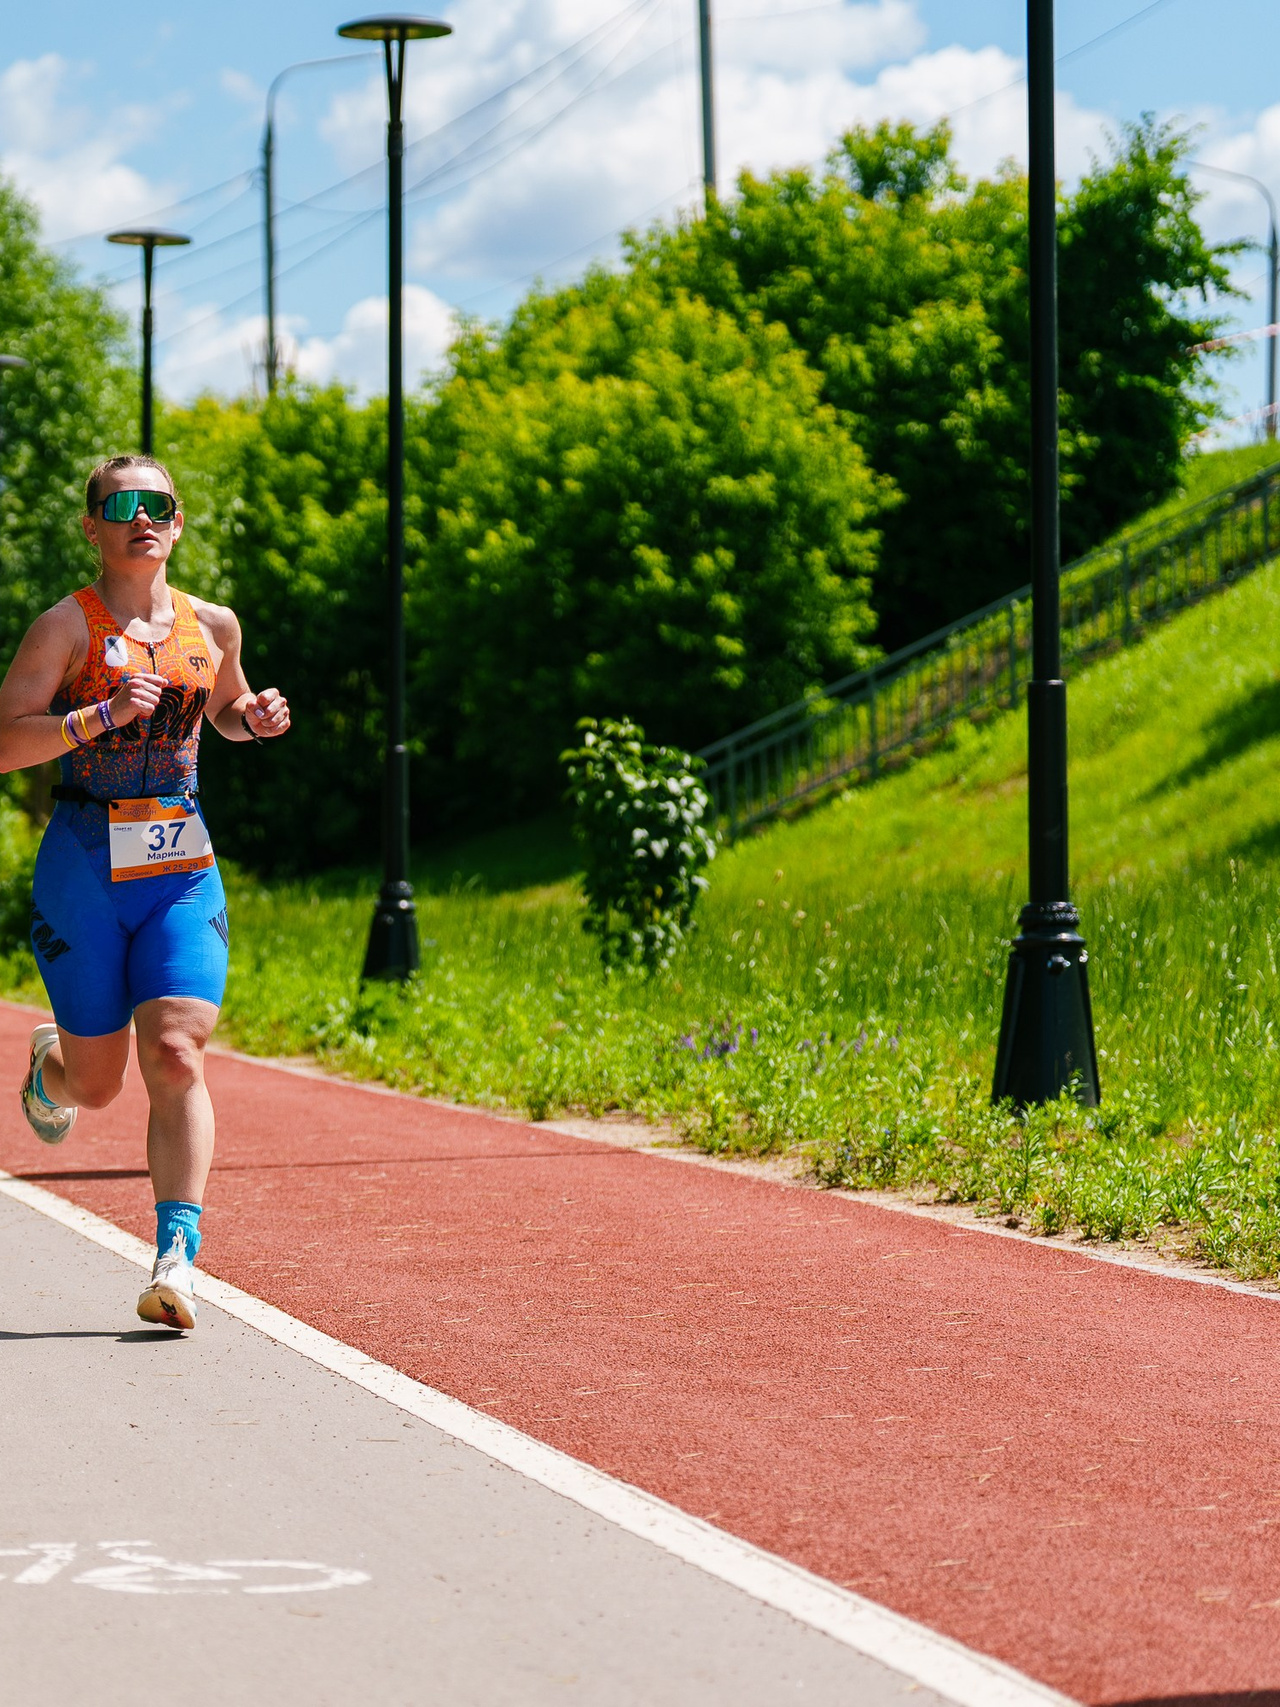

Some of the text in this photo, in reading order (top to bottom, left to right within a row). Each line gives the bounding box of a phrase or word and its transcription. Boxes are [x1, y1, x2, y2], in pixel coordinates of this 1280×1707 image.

[148, 821, 186, 851] 37
[147, 850, 186, 861] Марина
[173, 862, 198, 870] 25-29
